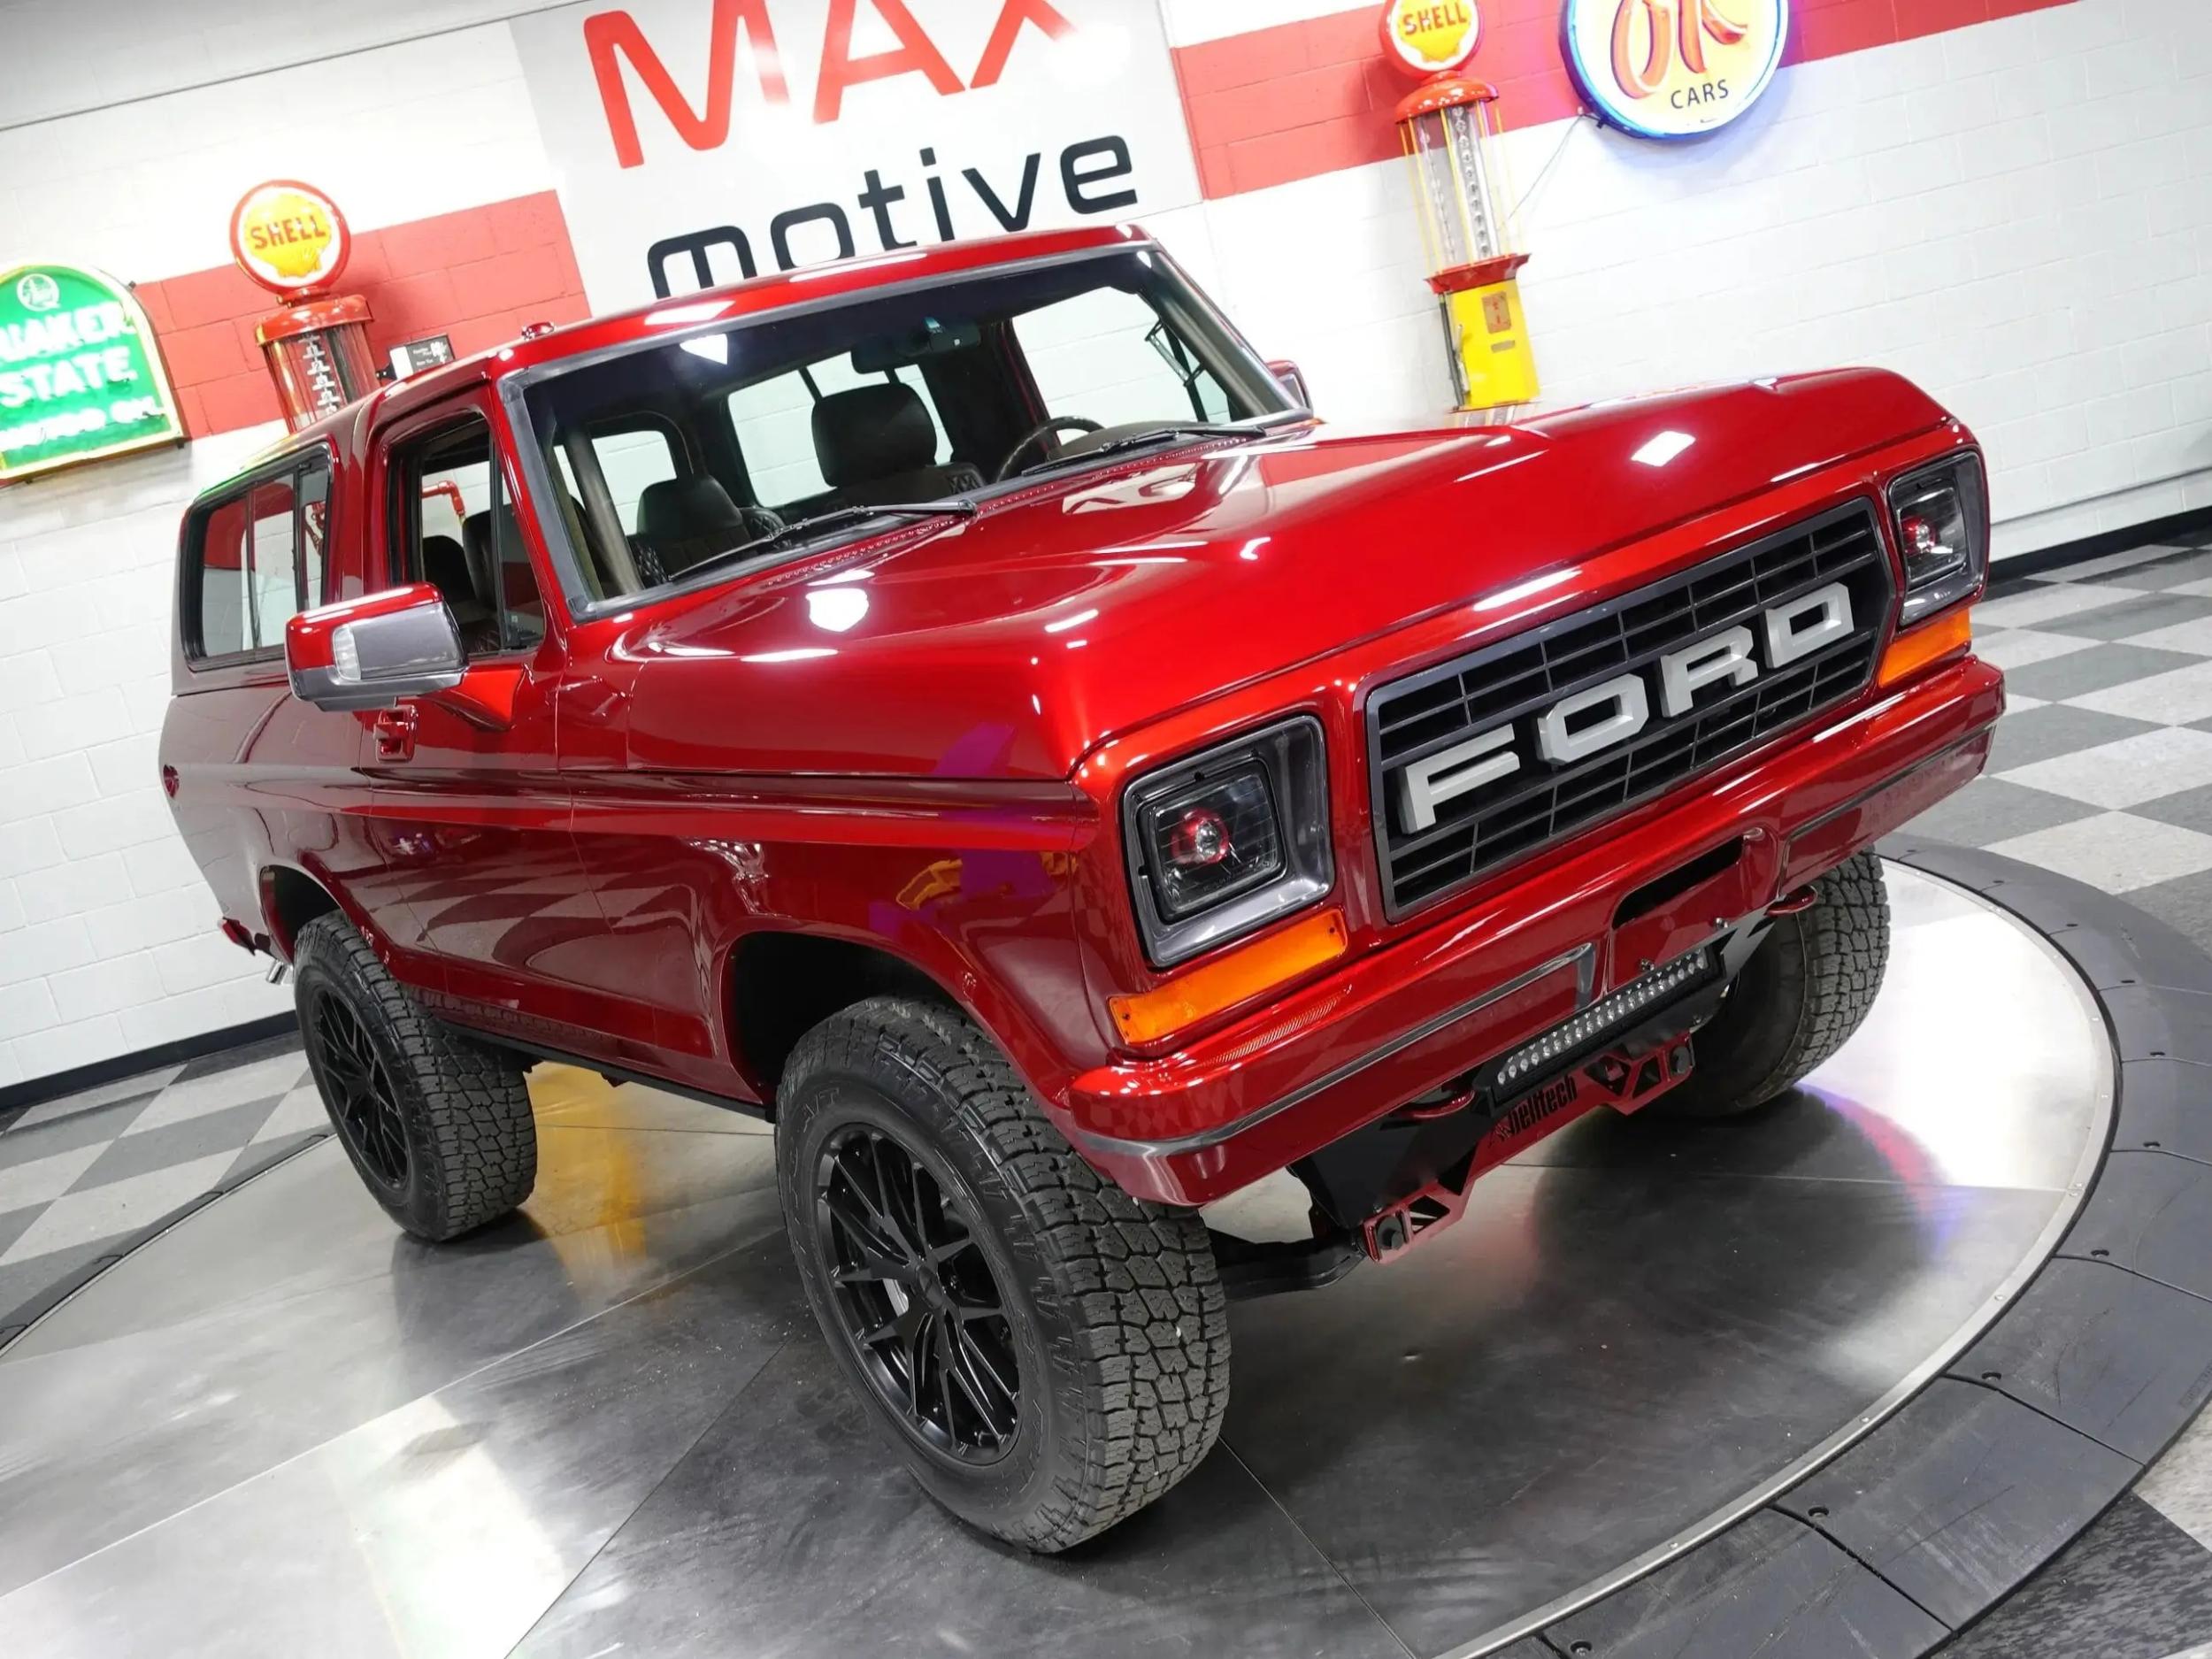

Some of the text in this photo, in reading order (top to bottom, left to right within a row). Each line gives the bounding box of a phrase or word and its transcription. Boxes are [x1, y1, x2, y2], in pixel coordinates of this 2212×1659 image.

[1402, 5, 1468, 36] SHELL
[1670, 79, 1730, 110] CARS
[250, 214, 327, 250] SHELL
[647, 134, 1138, 300] motive
[0, 346, 138, 409] STATE
[1401, 581, 1855, 834] FORD
